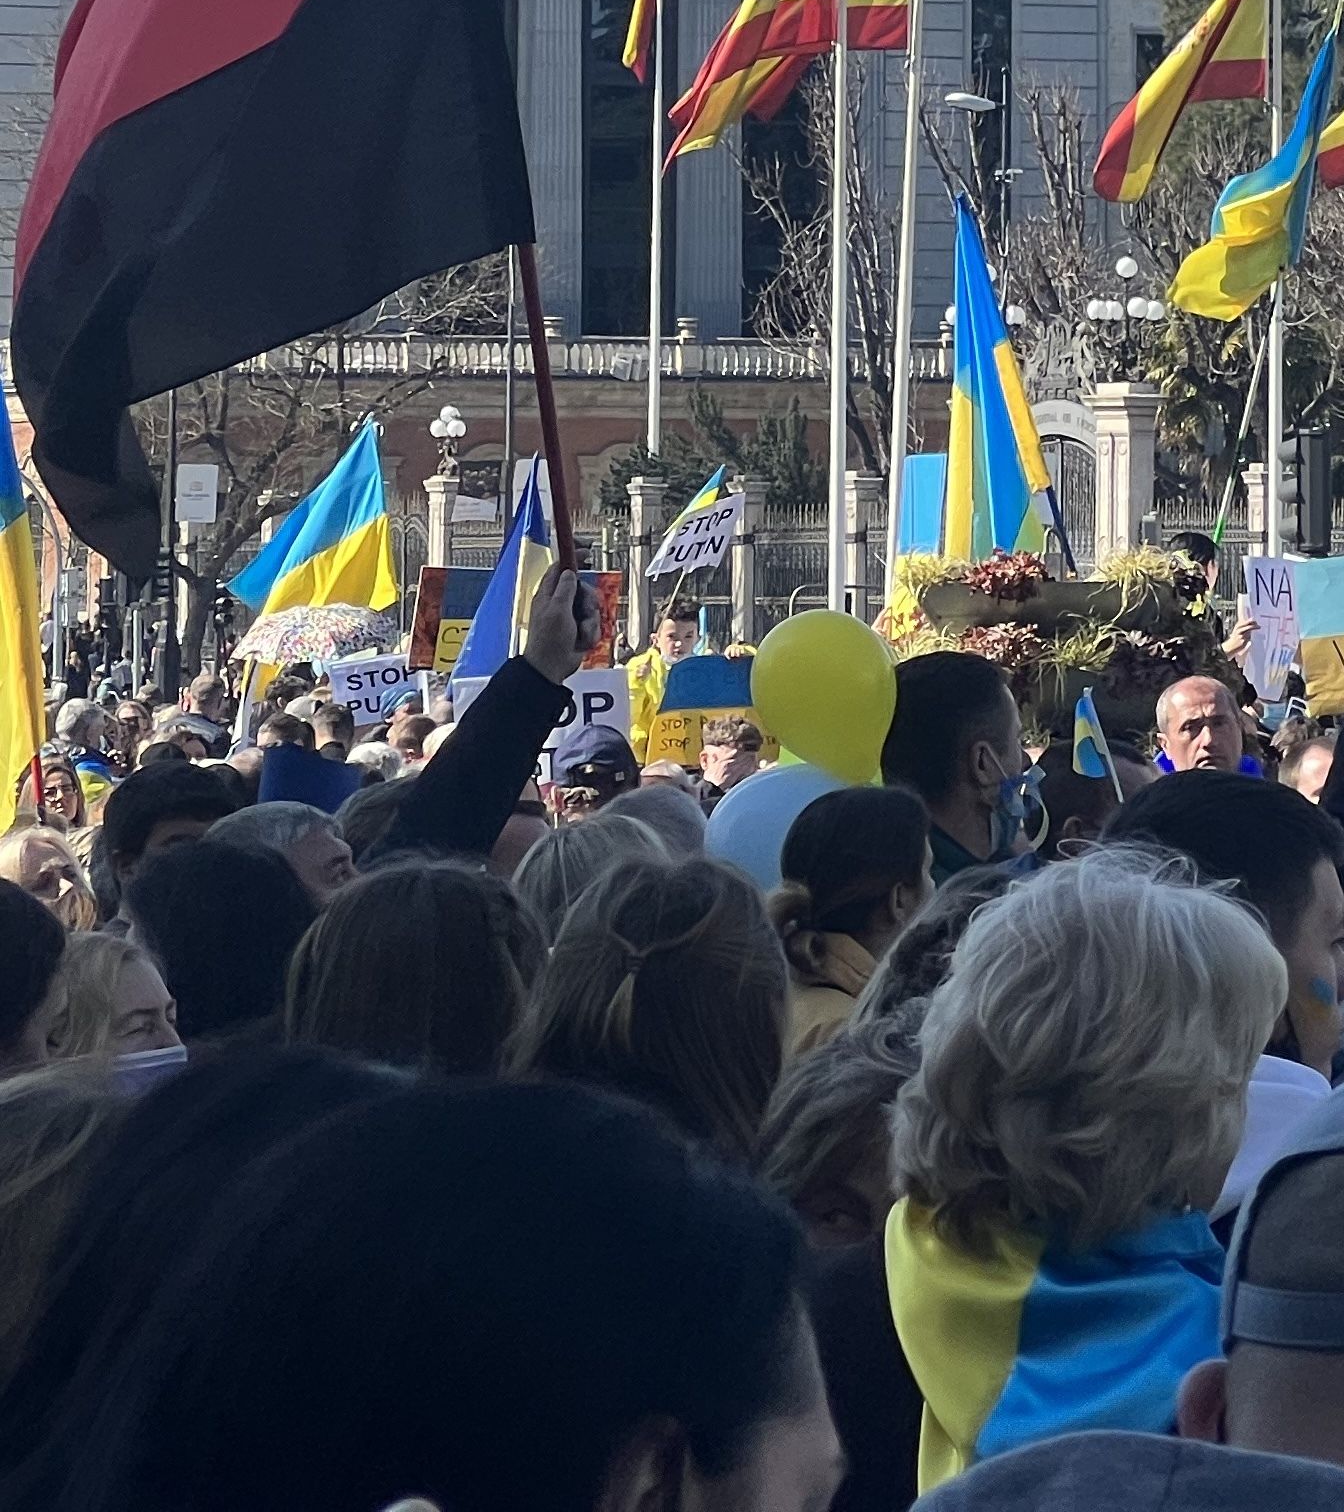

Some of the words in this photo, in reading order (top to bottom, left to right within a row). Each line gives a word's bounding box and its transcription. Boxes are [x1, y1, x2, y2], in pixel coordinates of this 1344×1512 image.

[677, 508, 734, 537] STOP
[667, 535, 725, 563] PUTN
[1255, 566, 1293, 612] NA
[346, 665, 418, 691] STOP
[661, 716, 692, 733] STOP
[660, 737, 691, 752] STOP
